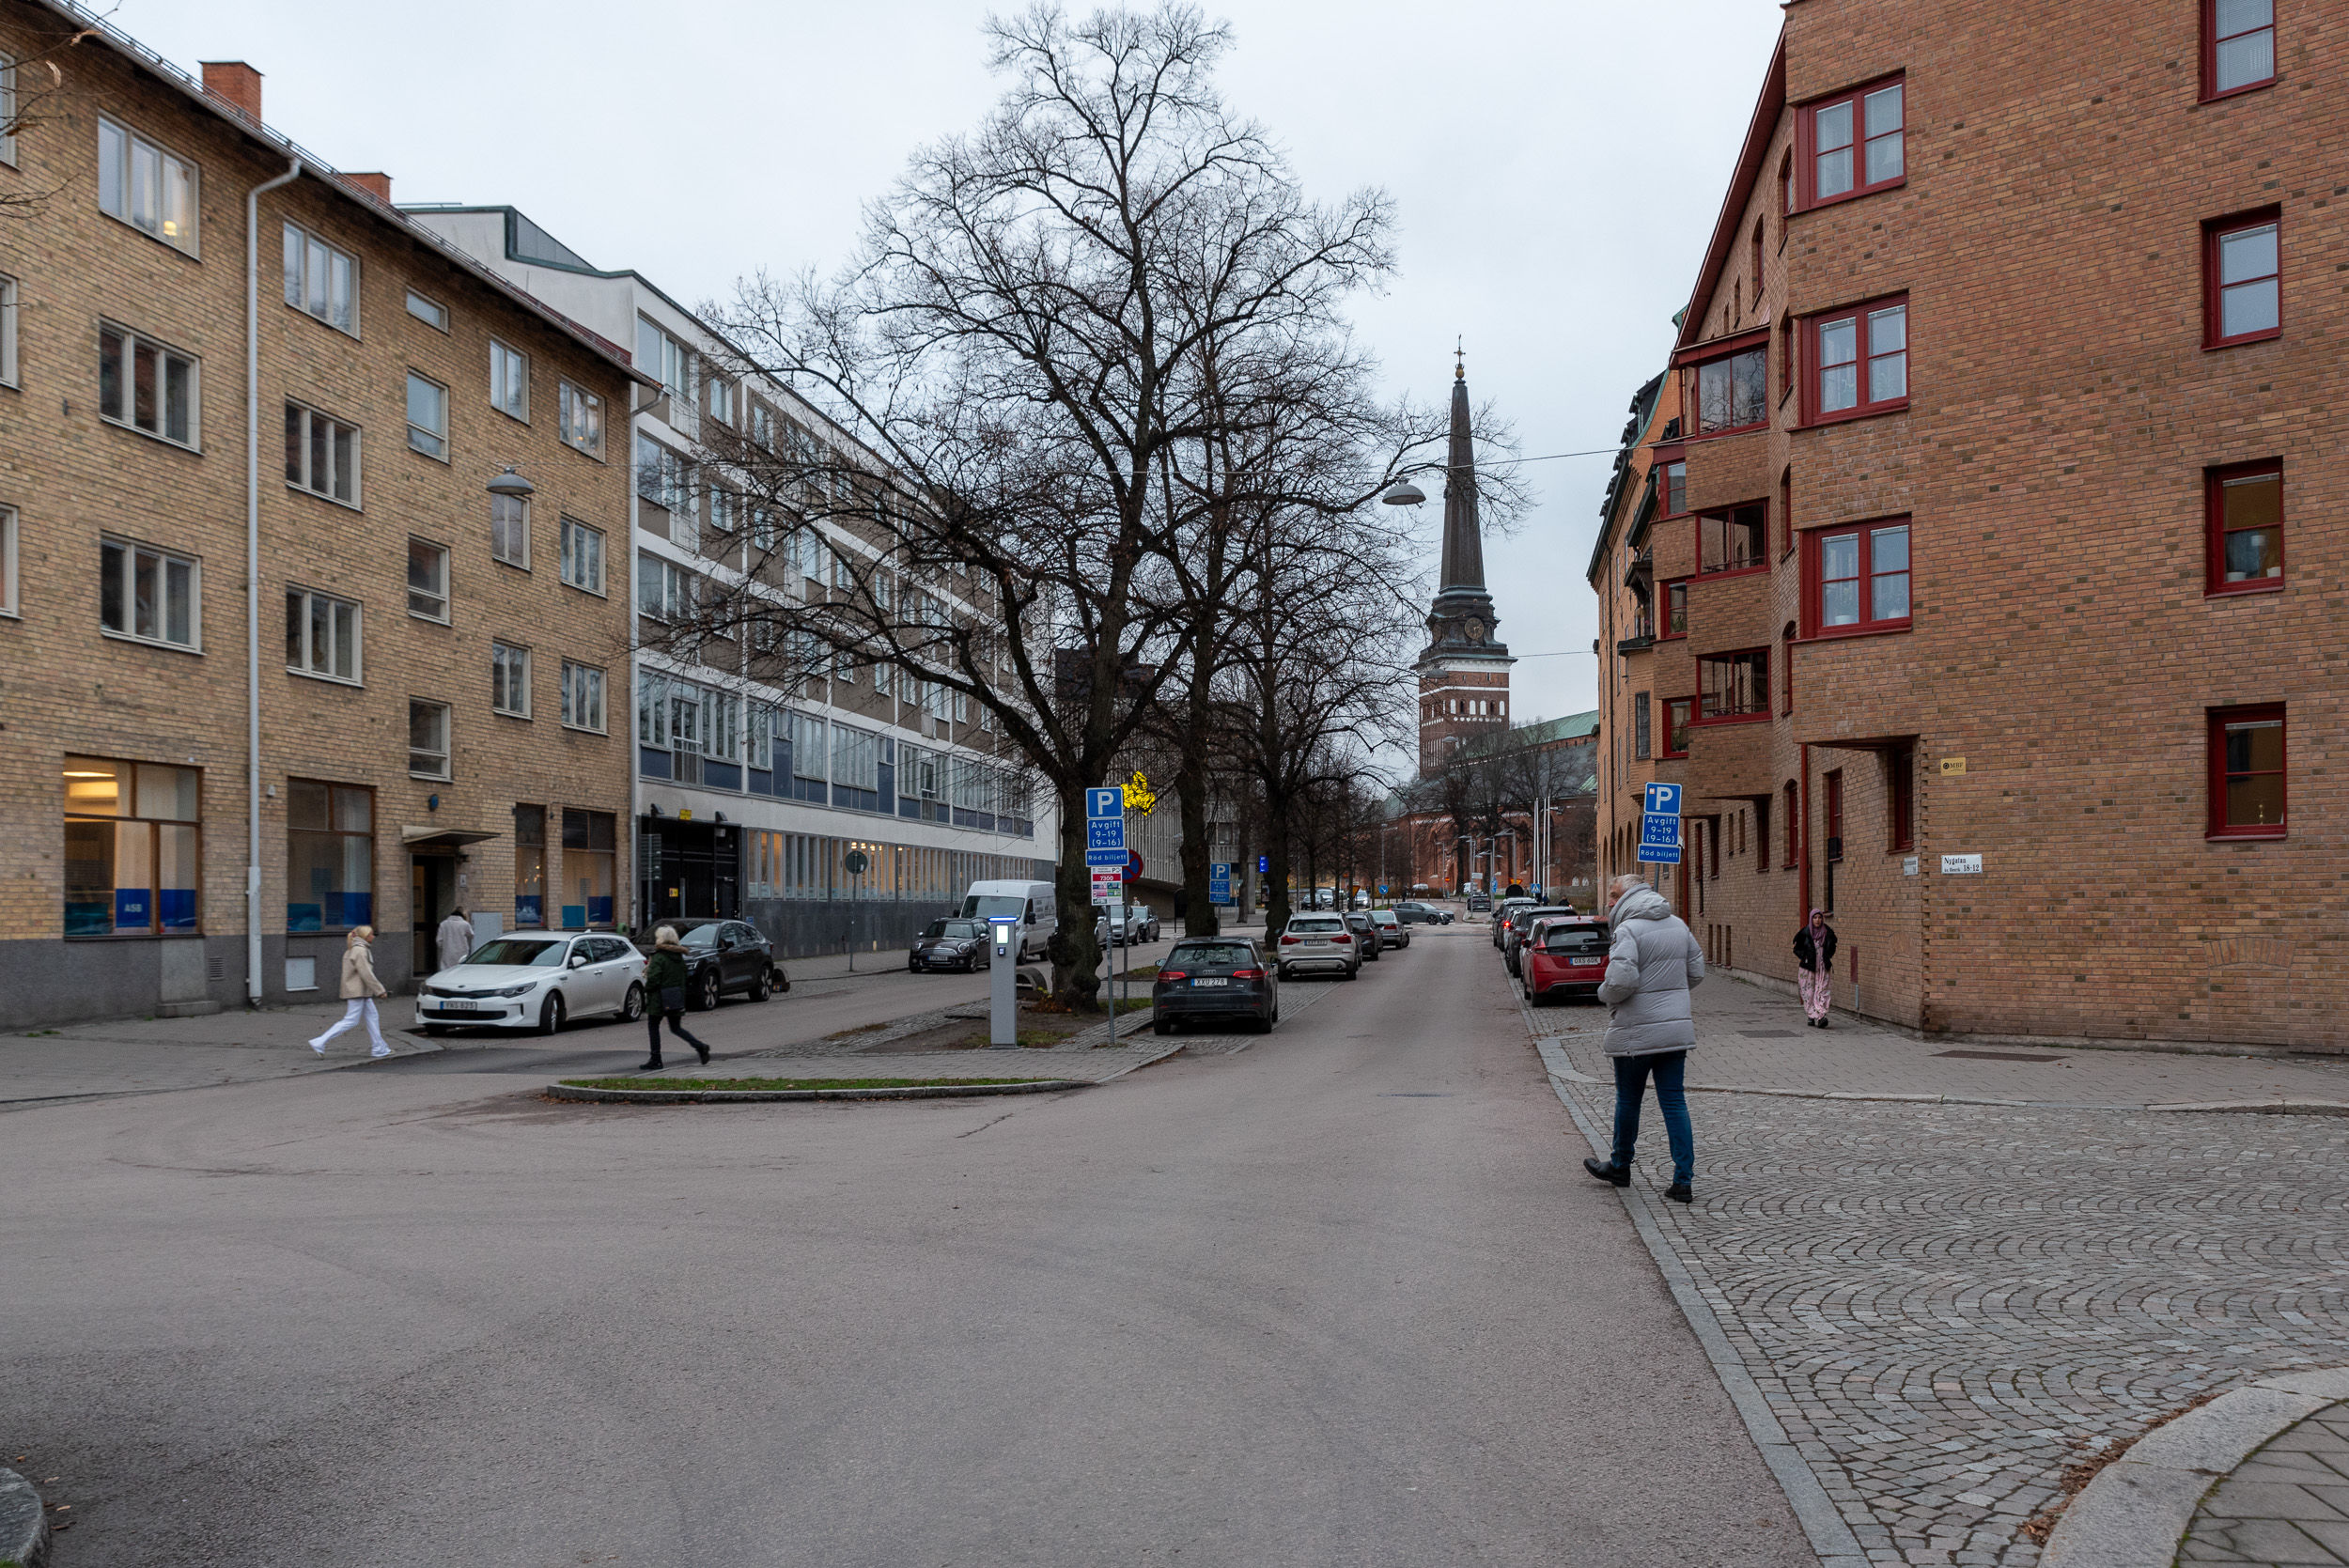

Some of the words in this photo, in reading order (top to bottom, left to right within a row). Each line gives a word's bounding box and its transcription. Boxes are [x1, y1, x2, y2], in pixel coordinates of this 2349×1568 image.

[1097, 791, 1114, 815] P
[1656, 786, 1673, 811] P
[1091, 820, 1120, 831] Avgift
[1647, 815, 1676, 826] Avgift
[1095, 830, 1116, 838] 9-19
[1650, 826, 1672, 834] 9-19
[1092, 837, 1121, 847] (9-16)
[1646, 833, 1675, 844] (9-16)
[1657, 850, 1678, 859] biljett
[1944, 857, 1967, 865] Nygatan
[1216, 864, 1226, 878] P
[1964, 863, 1980, 872] 18-12
